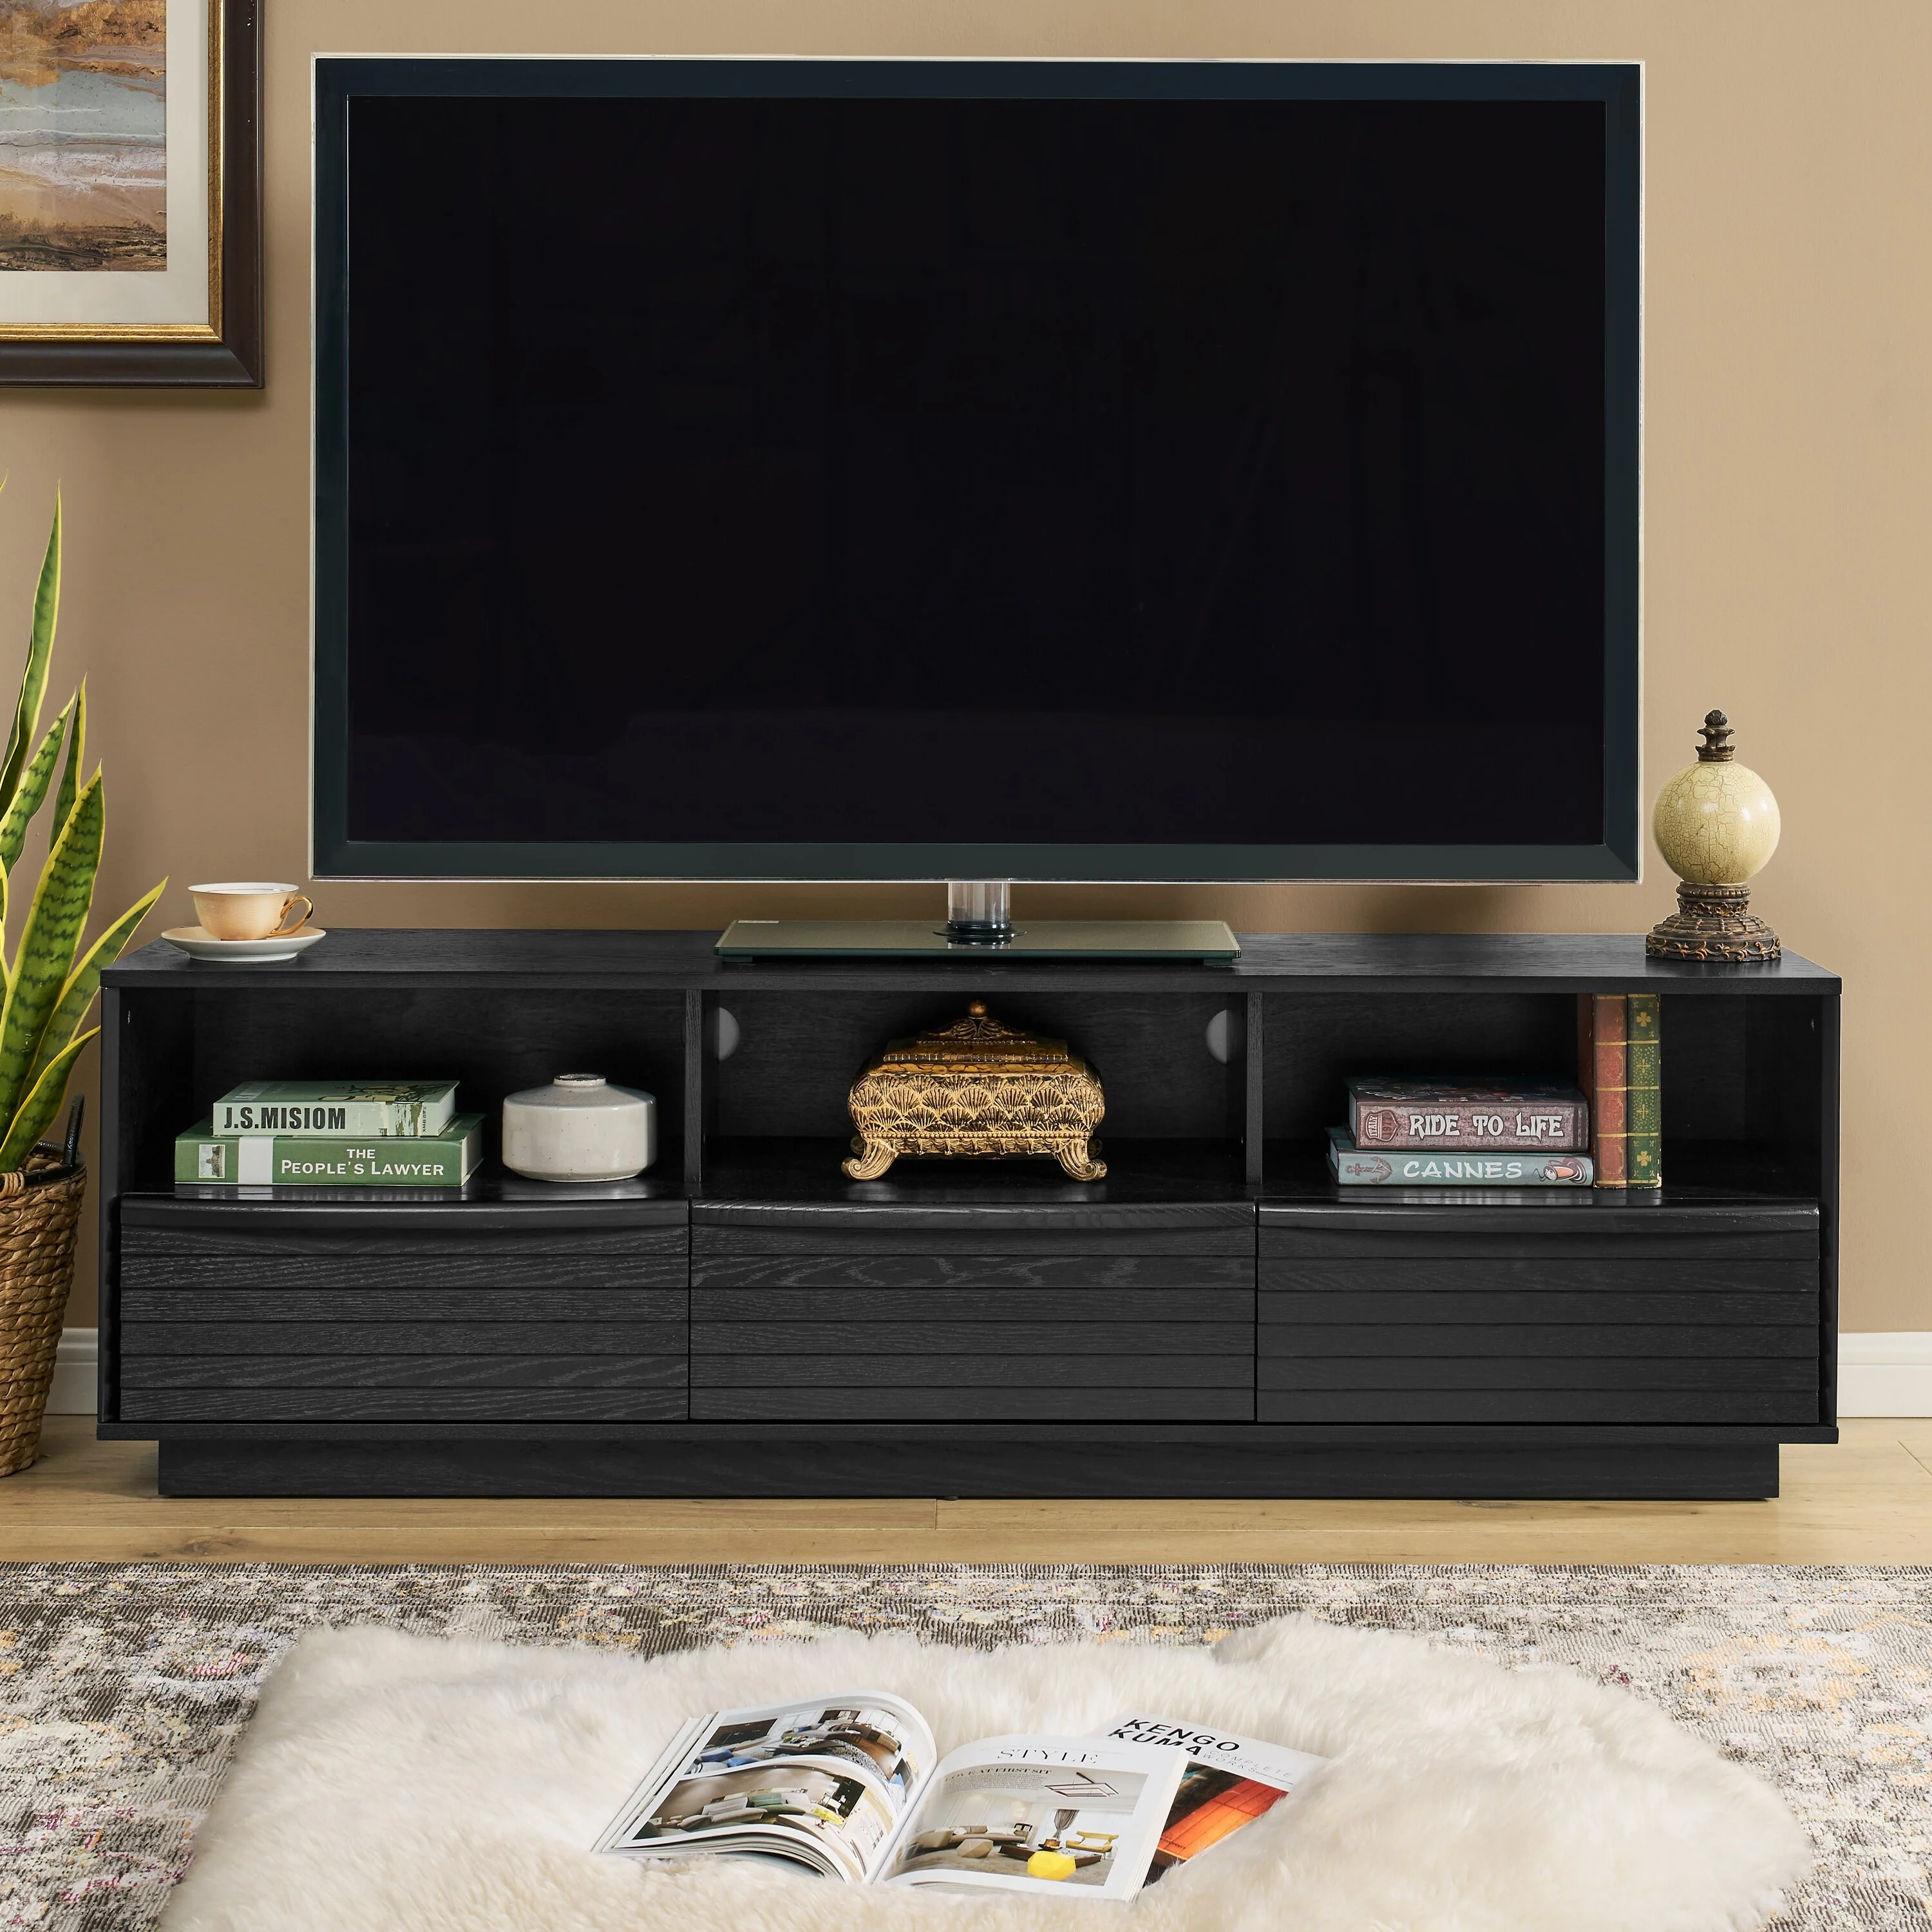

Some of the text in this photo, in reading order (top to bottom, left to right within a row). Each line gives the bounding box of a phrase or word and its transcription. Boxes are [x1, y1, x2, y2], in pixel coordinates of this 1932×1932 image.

[224, 1106, 346, 1129] J.S.MISIOM
[1368, 1115, 1378, 1137] ITALY
[1382, 1117, 1392, 1135] 1977
[1409, 1112, 1564, 1143] RIDE TO LIFE
[346, 1149, 375, 1159] THE
[371, 1161, 444, 1175] LAWYER
[1403, 1160, 1522, 1179] CANNES
[1107, 1728, 1202, 1756] KUMA
[1123, 1719, 1239, 1751] KENGO
[998, 1749, 1098, 1764] STYLE
[1203, 1753, 1258, 1772] WORKS
[1209, 1750, 1293, 1778] COMPLETE
